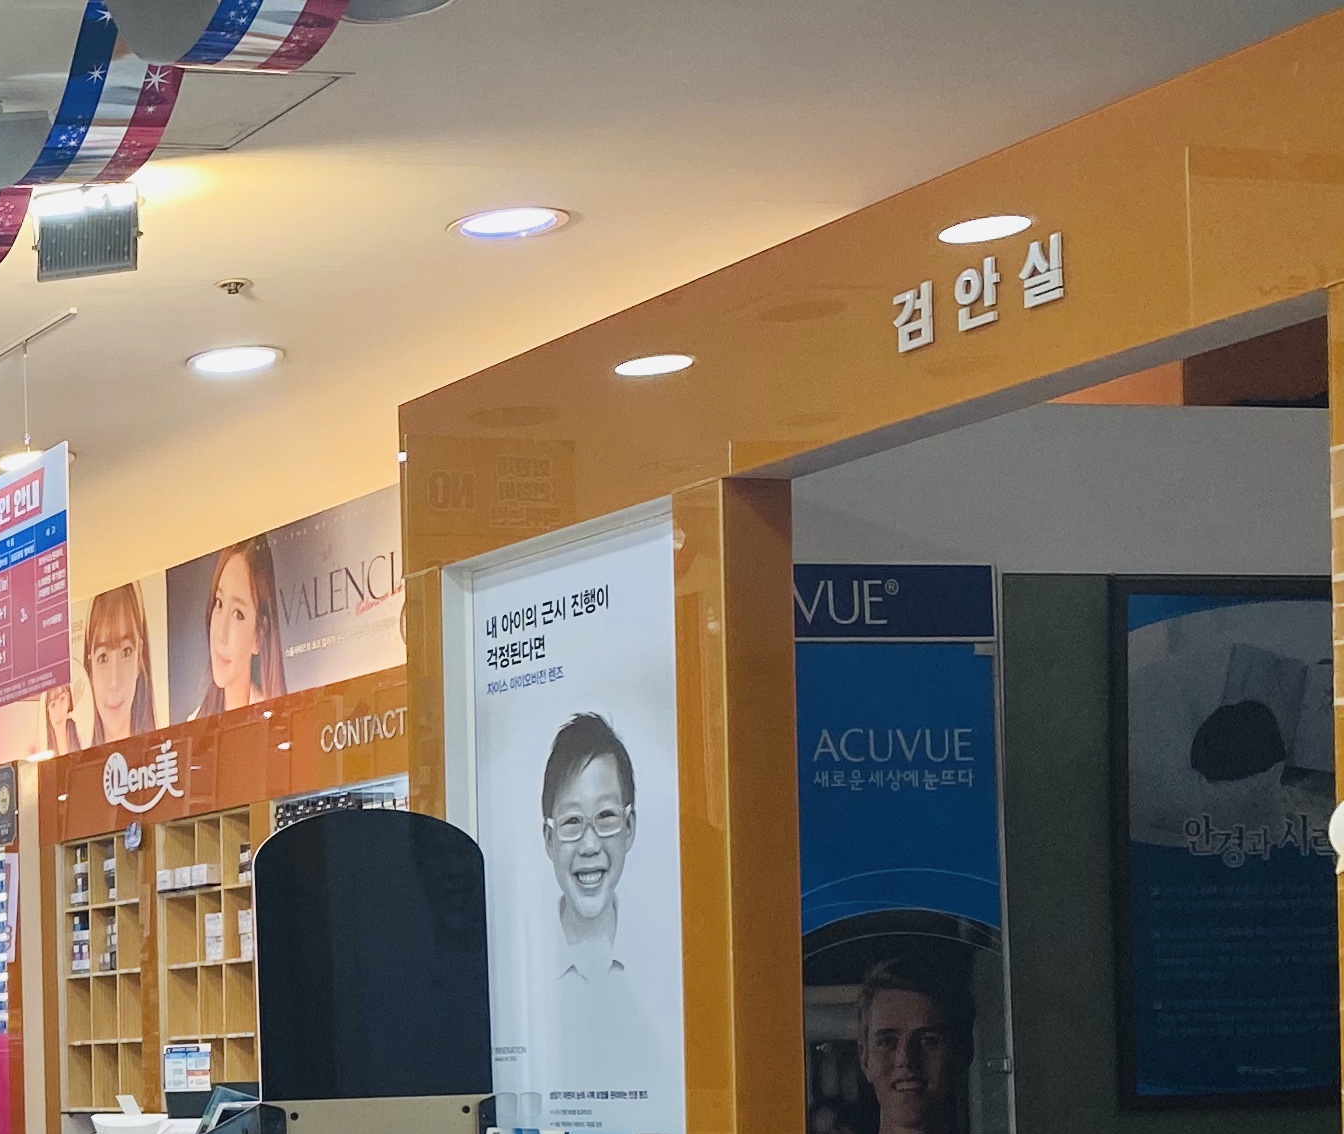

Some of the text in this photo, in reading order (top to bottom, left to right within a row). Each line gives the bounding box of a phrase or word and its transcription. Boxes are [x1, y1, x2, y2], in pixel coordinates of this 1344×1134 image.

[13, 479, 40, 518] 안내
[278, 551, 400, 627] VALENCI
[486, 584, 609, 638] 내 아이의 근시 진행이
[794, 578, 900, 625] VUE®
[486, 634, 546, 670] 걱정된다면
[321, 706, 408, 753] CONTACT
[813, 728, 975, 763] ACUVUE
[1184, 813, 1271, 868] 안경과
